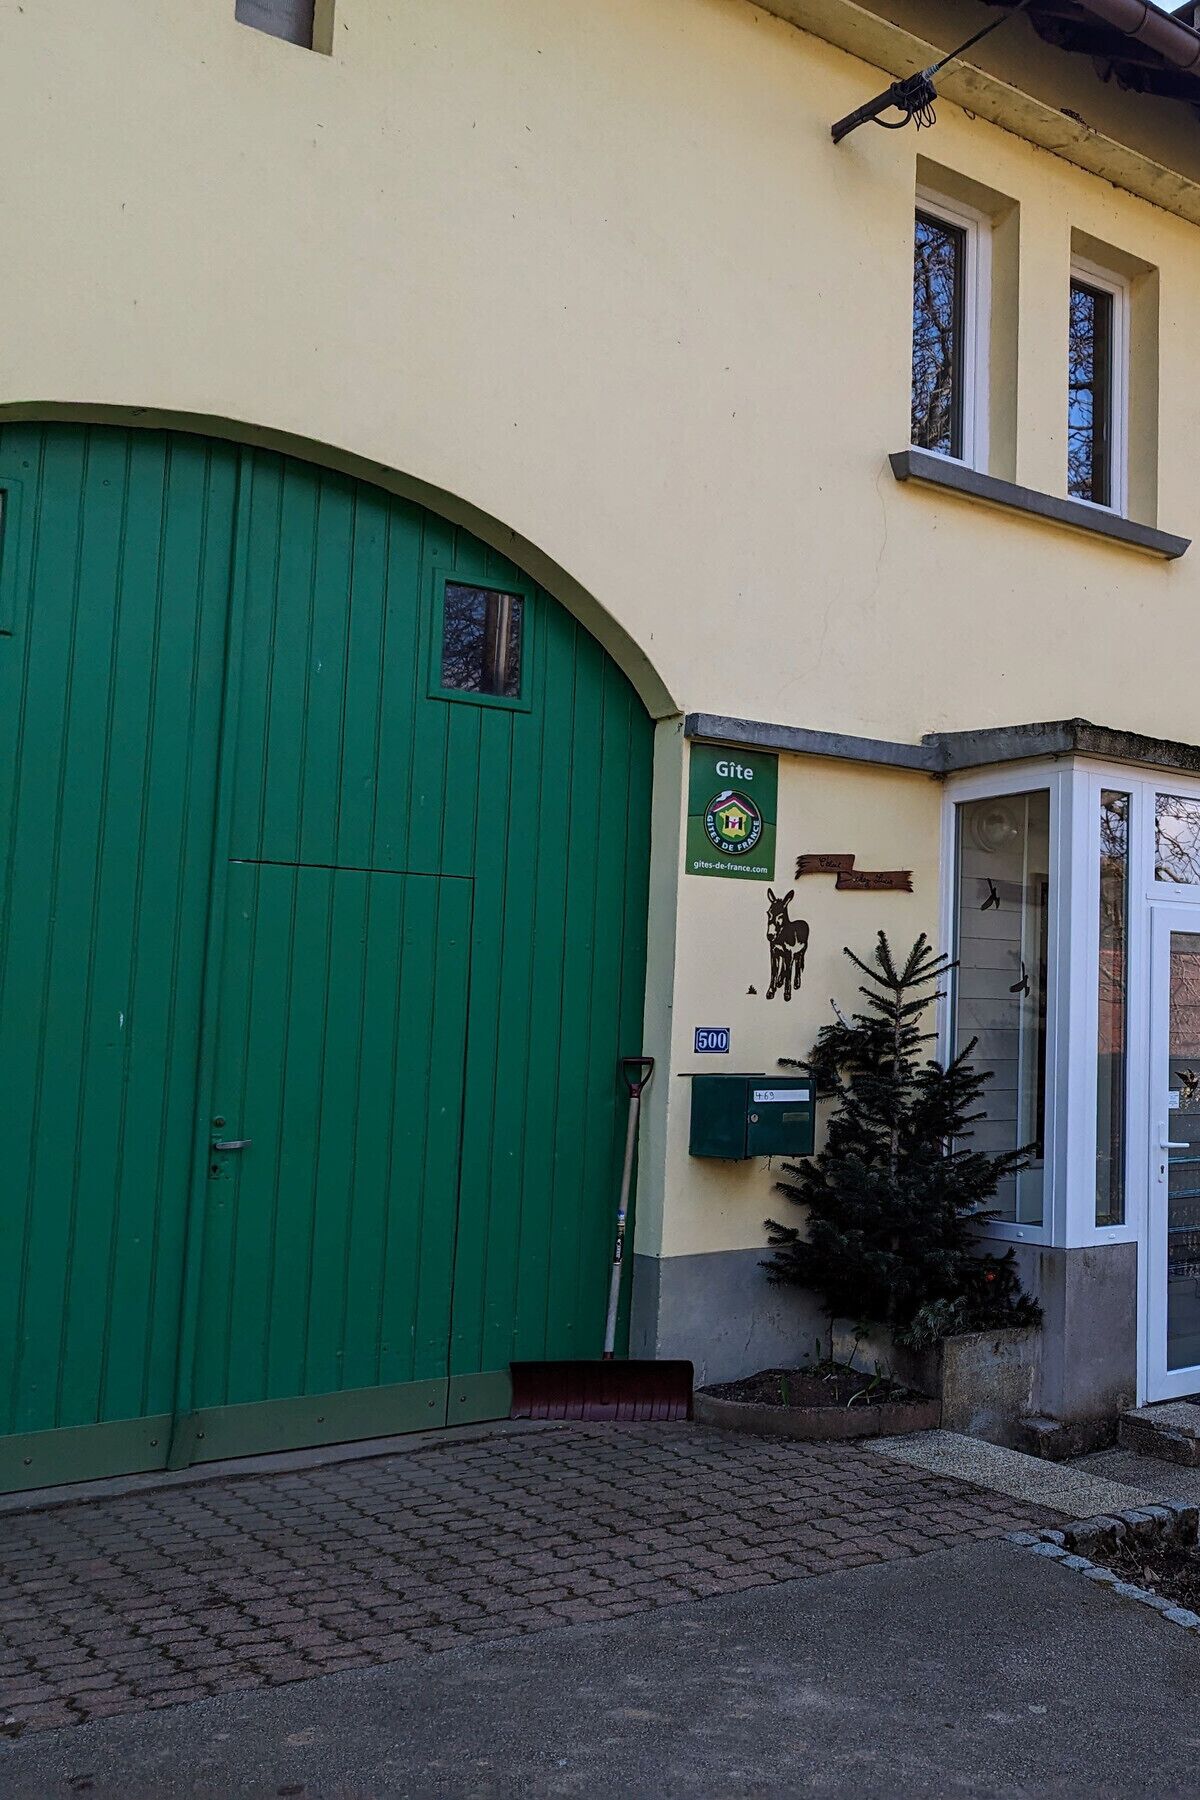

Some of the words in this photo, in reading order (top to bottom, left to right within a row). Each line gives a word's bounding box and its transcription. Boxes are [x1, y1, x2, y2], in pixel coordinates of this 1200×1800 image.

[716, 761, 754, 780] Gîte
[722, 842, 734, 851] DE
[737, 820, 760, 851] FRANCE
[693, 860, 768, 874] gites-de-france.com
[698, 1032, 727, 1049] 500
